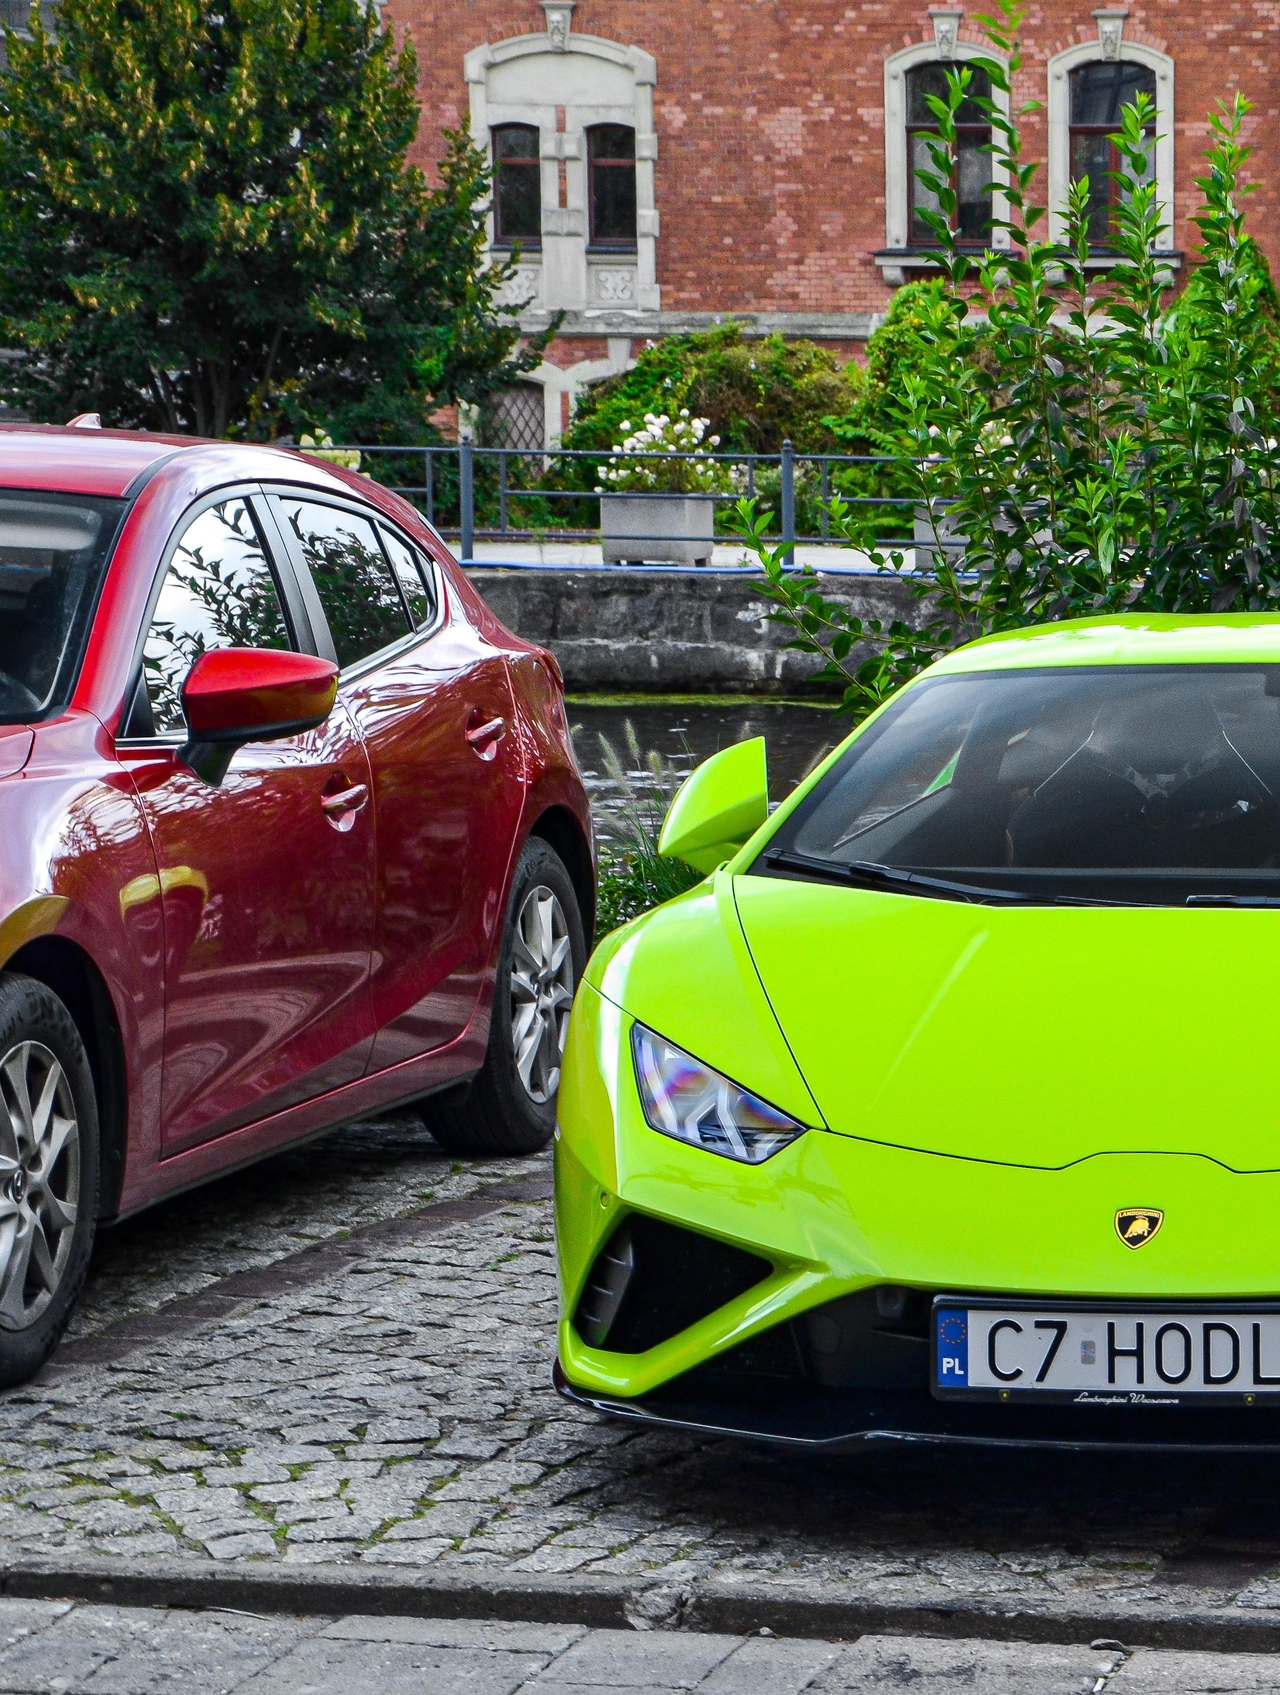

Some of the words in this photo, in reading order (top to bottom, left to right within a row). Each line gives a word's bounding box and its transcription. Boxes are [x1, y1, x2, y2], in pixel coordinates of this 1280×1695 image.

[1119, 1210, 1160, 1218] LAMBORGHINI
[988, 1319, 1067, 1382] C7
[942, 1357, 964, 1375] PL
[1073, 1391, 1128, 1405] Lamborghini
[1129, 1392, 1179, 1404] Warszawa
